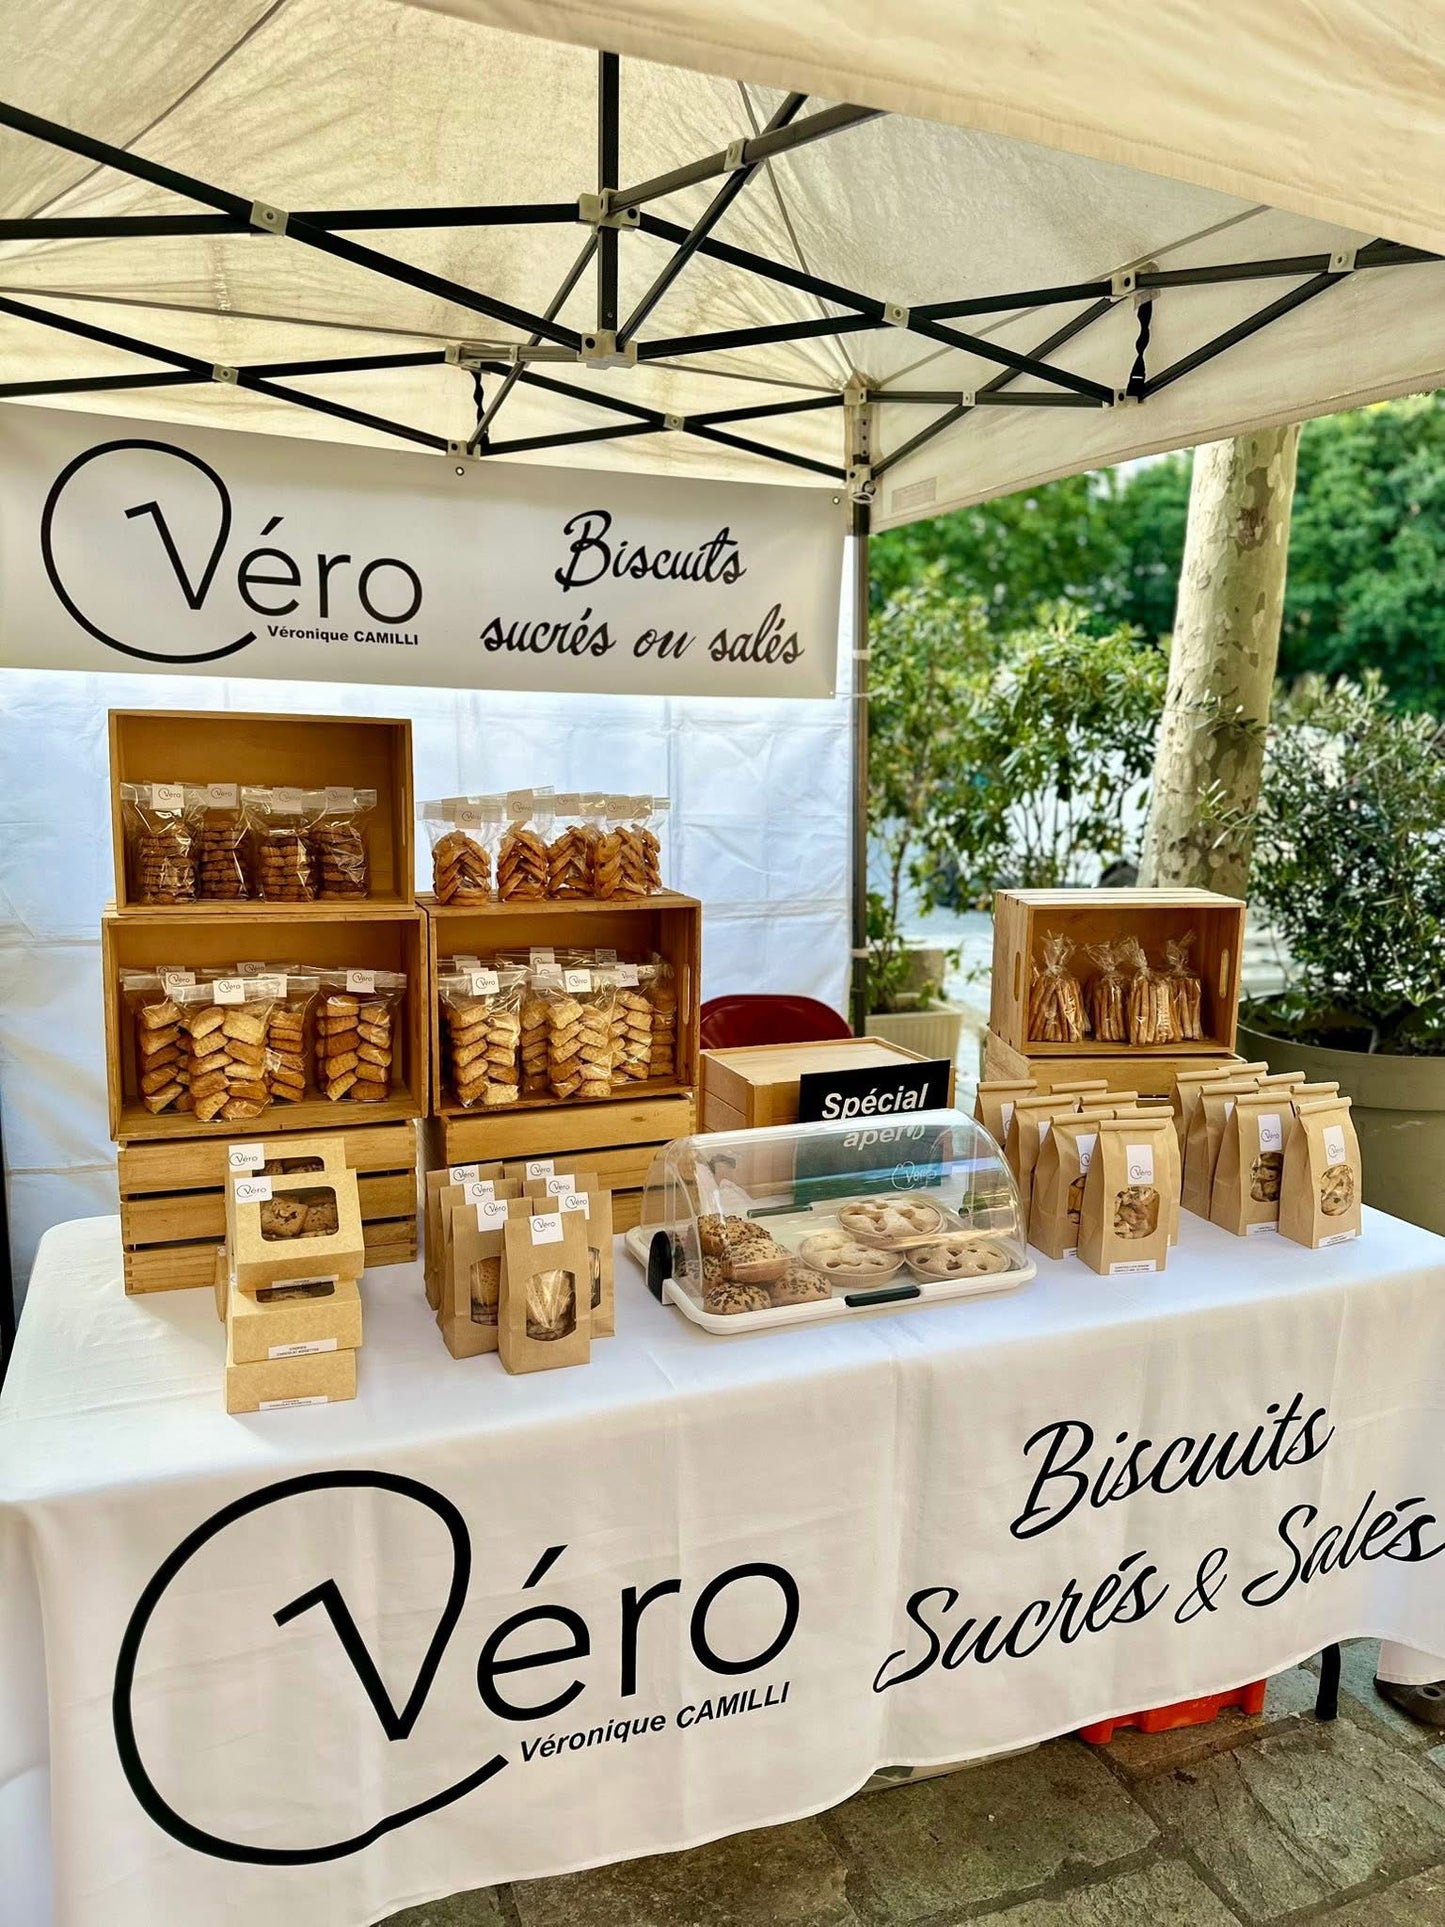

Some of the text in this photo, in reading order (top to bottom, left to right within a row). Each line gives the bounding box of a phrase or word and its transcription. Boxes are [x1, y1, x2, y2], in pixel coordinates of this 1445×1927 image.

[41, 438, 423, 664] Véro
[555, 510, 747, 593] Biscuits
[267, 624, 419, 646] Véronique CAMILLI
[480, 604, 804, 665] sucrés ou salés
[821, 1082, 930, 1120] Spécial
[1009, 1392, 1336, 1540] Biscuits
[872, 1490, 1445, 1695] Sucrés & Salés
[112, 1470, 801, 1866] Véro
[520, 1681, 790, 1763] Véronique CAMILLI
